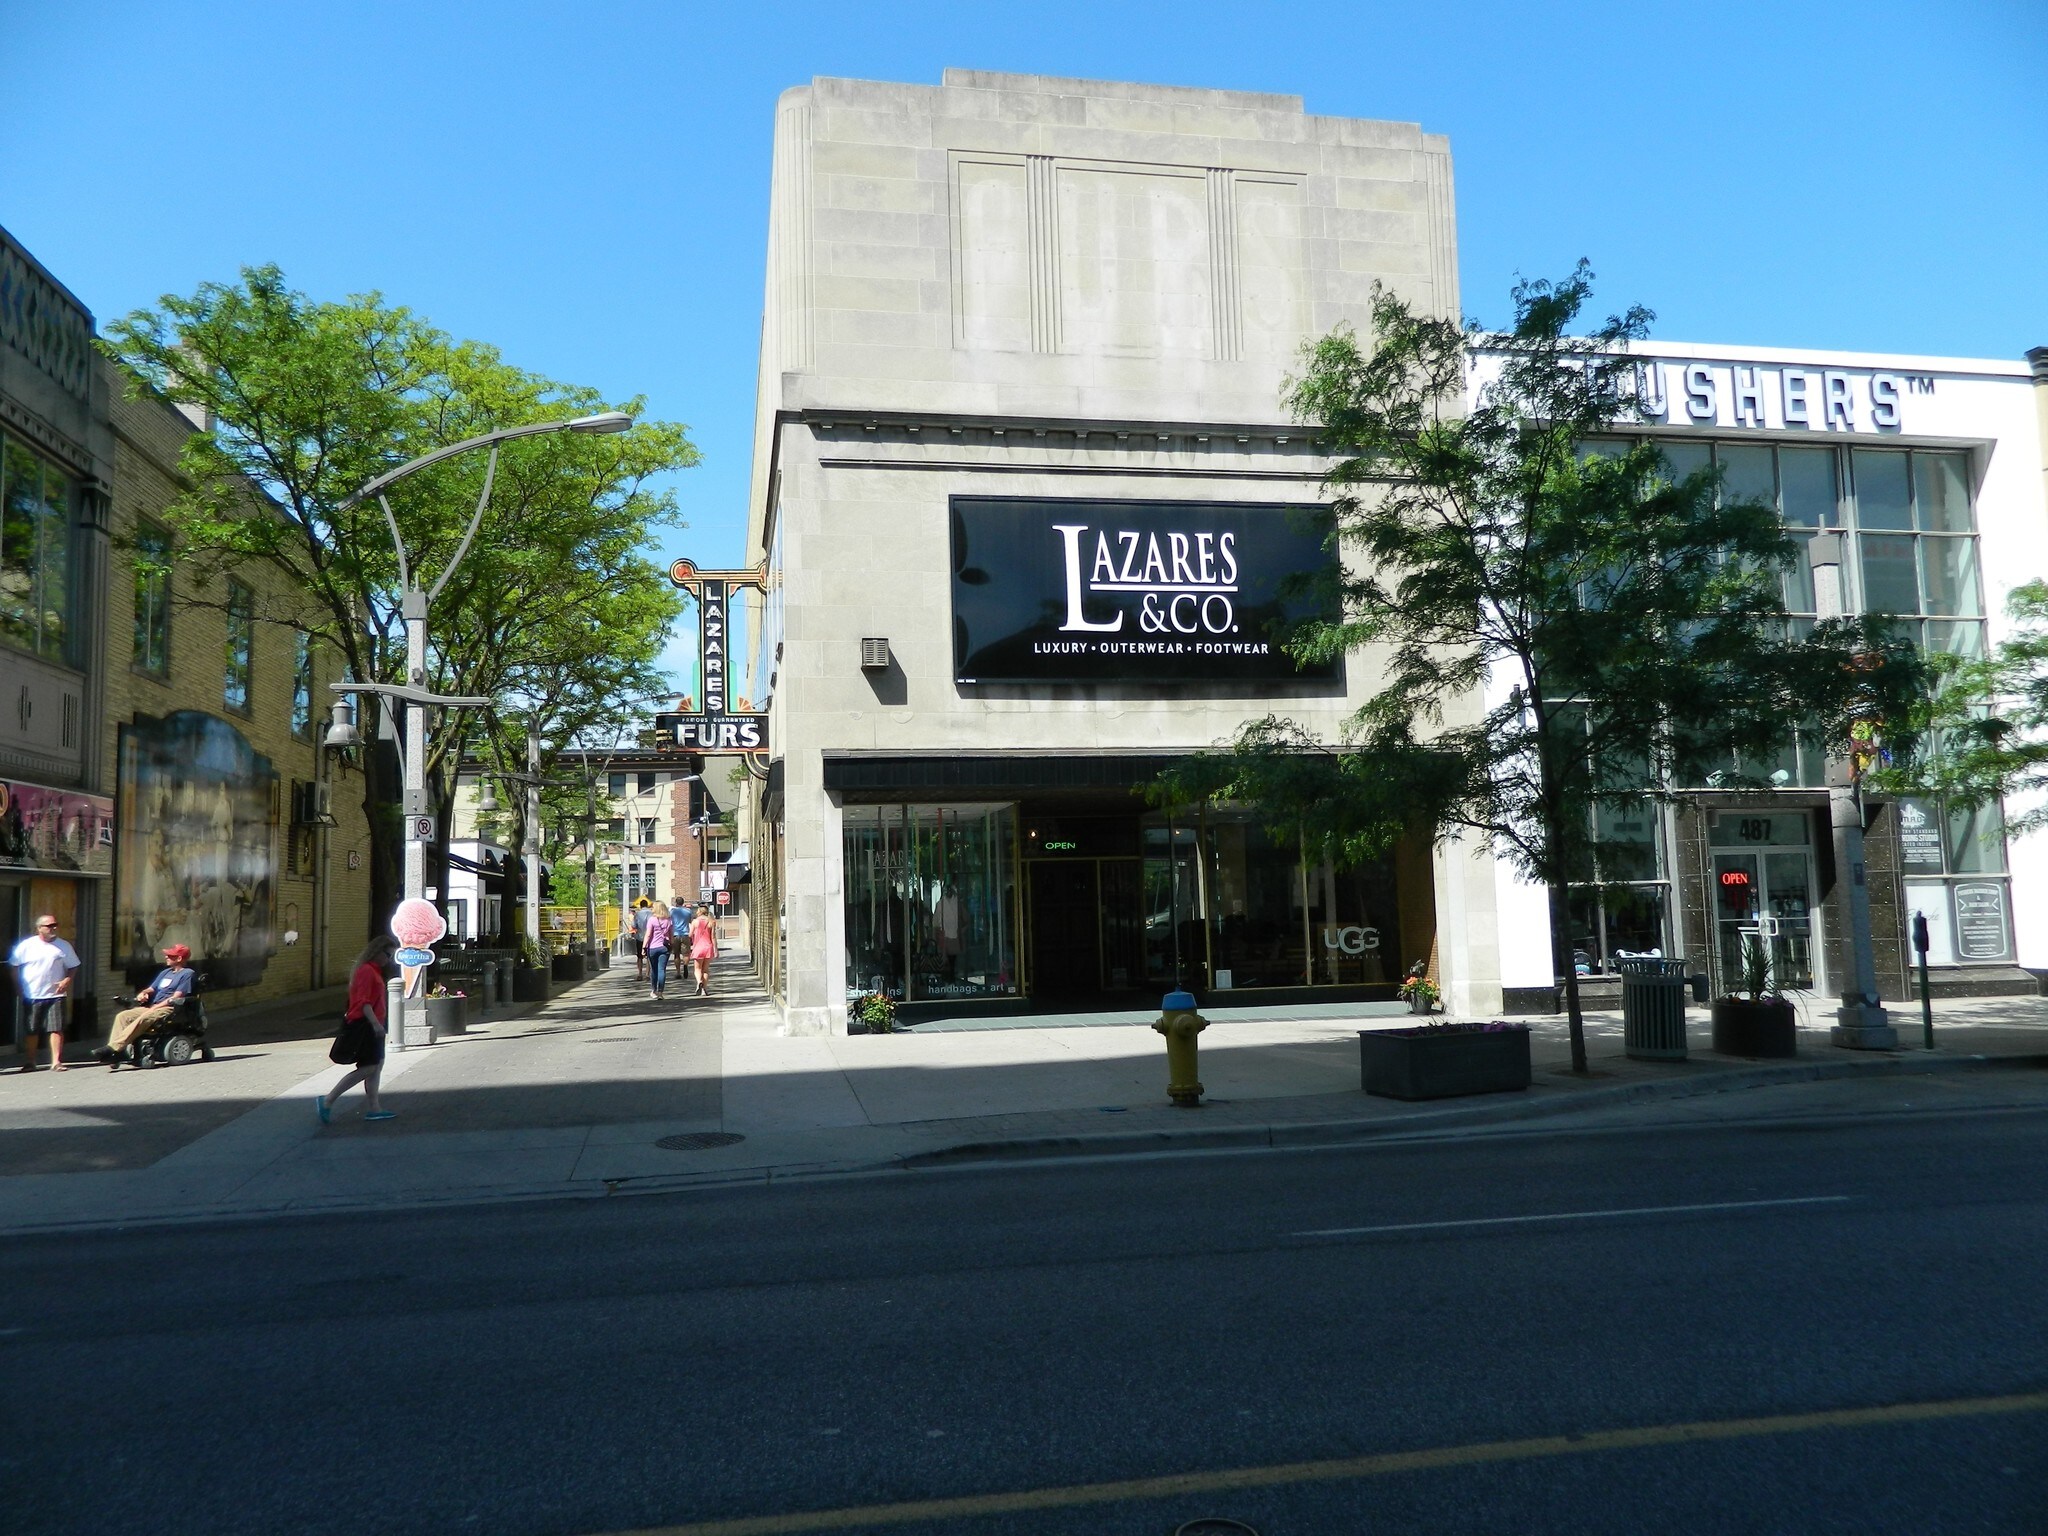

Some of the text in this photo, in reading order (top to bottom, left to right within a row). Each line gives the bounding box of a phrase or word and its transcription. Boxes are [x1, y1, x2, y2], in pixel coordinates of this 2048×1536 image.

[1905, 376, 1934, 395] TM
[1052, 525, 1239, 632] LAZARES
[705, 586, 723, 711] LAZARES
[1034, 642, 1269, 655] LUXURY OUTERWEAR FOOTWEAR
[677, 723, 760, 748] FURS
[1739, 819, 1771, 841] 487
[1045, 842, 1076, 850] OPEN
[1722, 872, 1749, 885] OPEN
[1324, 926, 1380, 955] UGG
[928, 983, 1004, 995] handbags art
